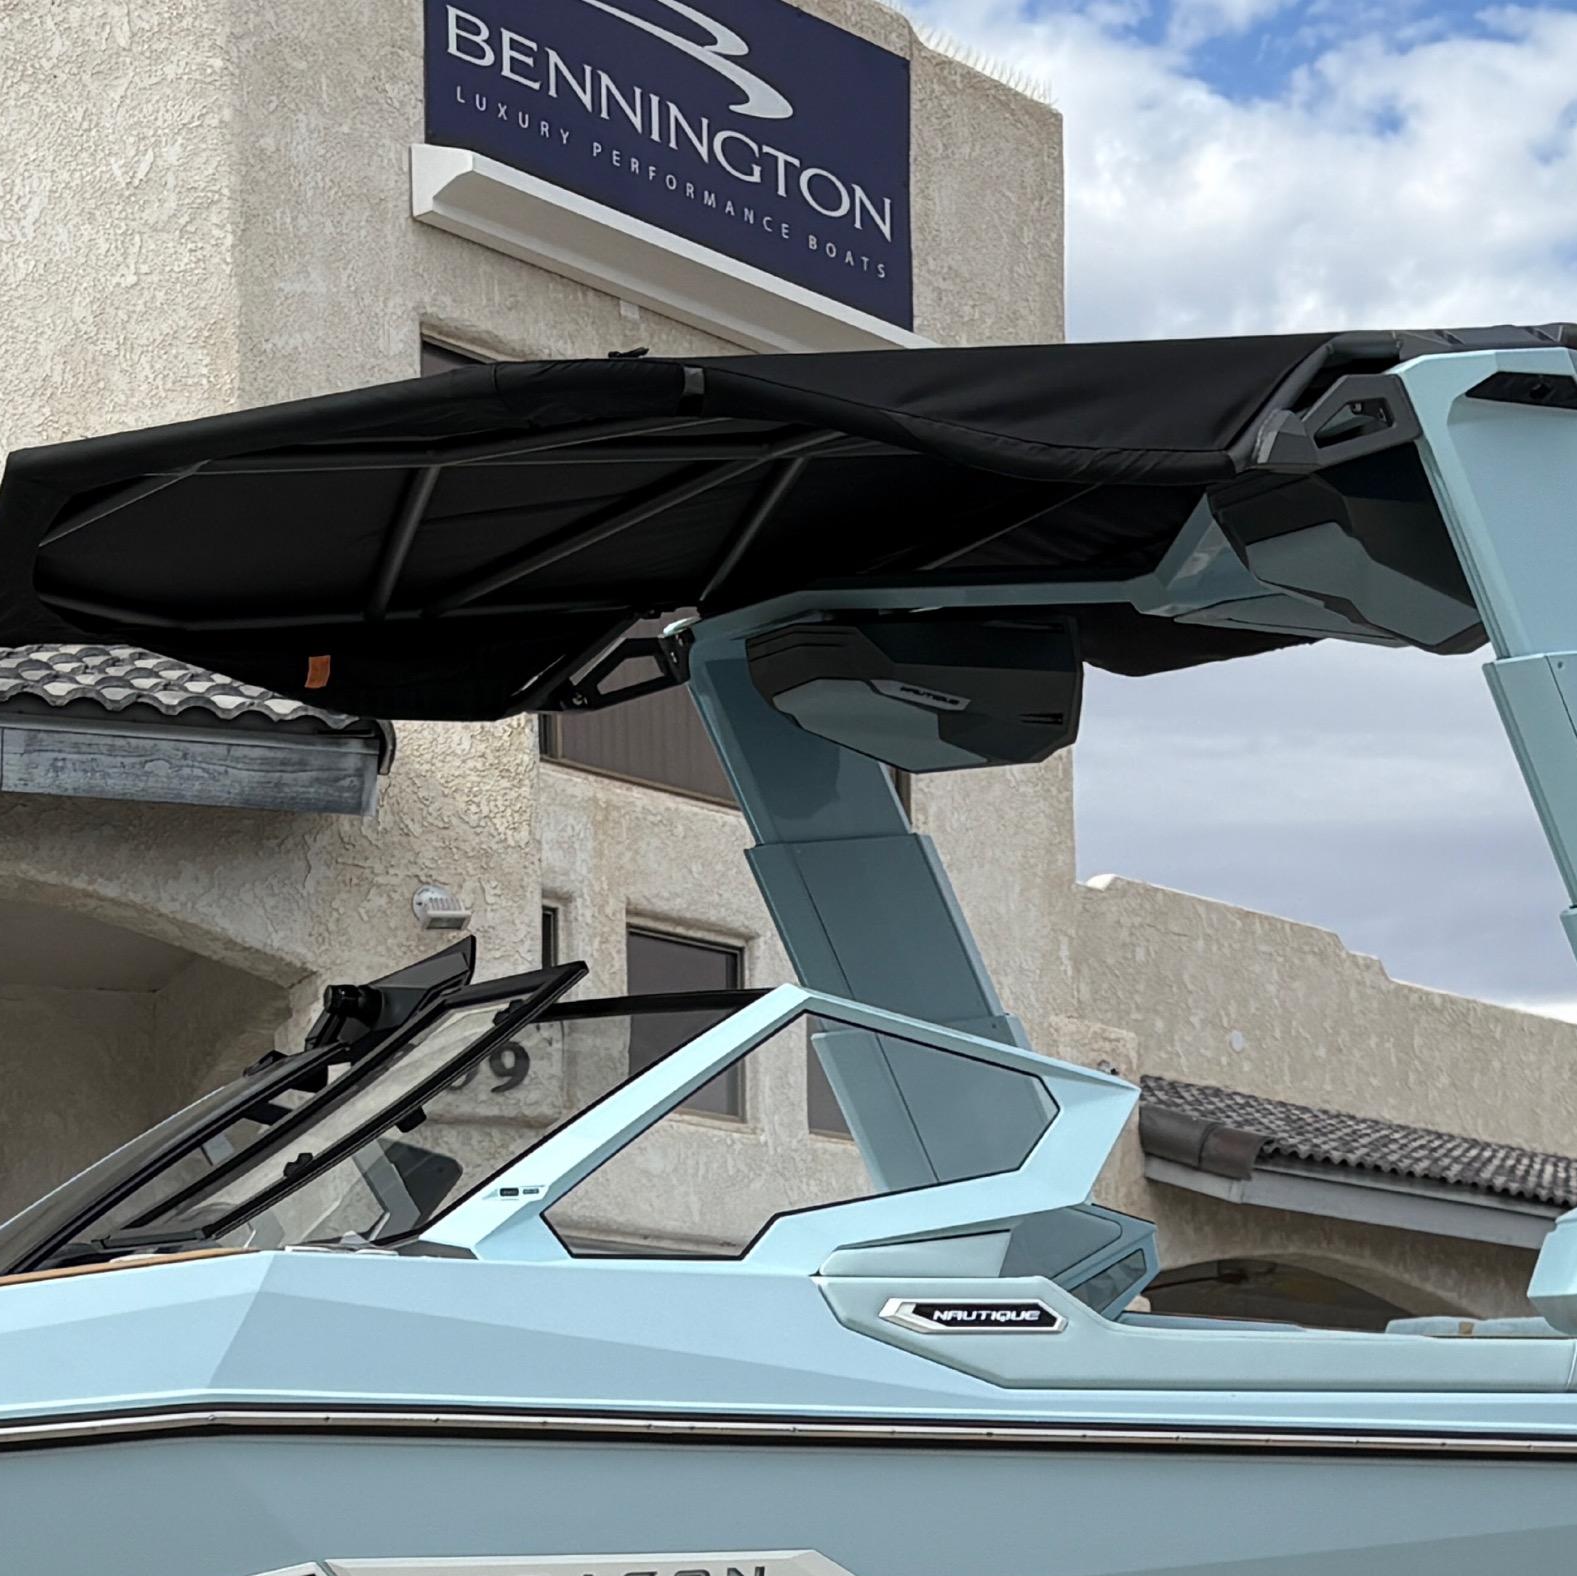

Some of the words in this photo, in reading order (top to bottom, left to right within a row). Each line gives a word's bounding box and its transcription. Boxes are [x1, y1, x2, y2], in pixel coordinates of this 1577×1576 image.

[446, 5, 892, 242] BENNINGTON
[456, 85, 570, 145] LUXURY
[593, 142, 790, 239] PERFORMANCE
[808, 234, 886, 279] BOATS
[933, 1310, 1041, 1322] NAUTIQUE
